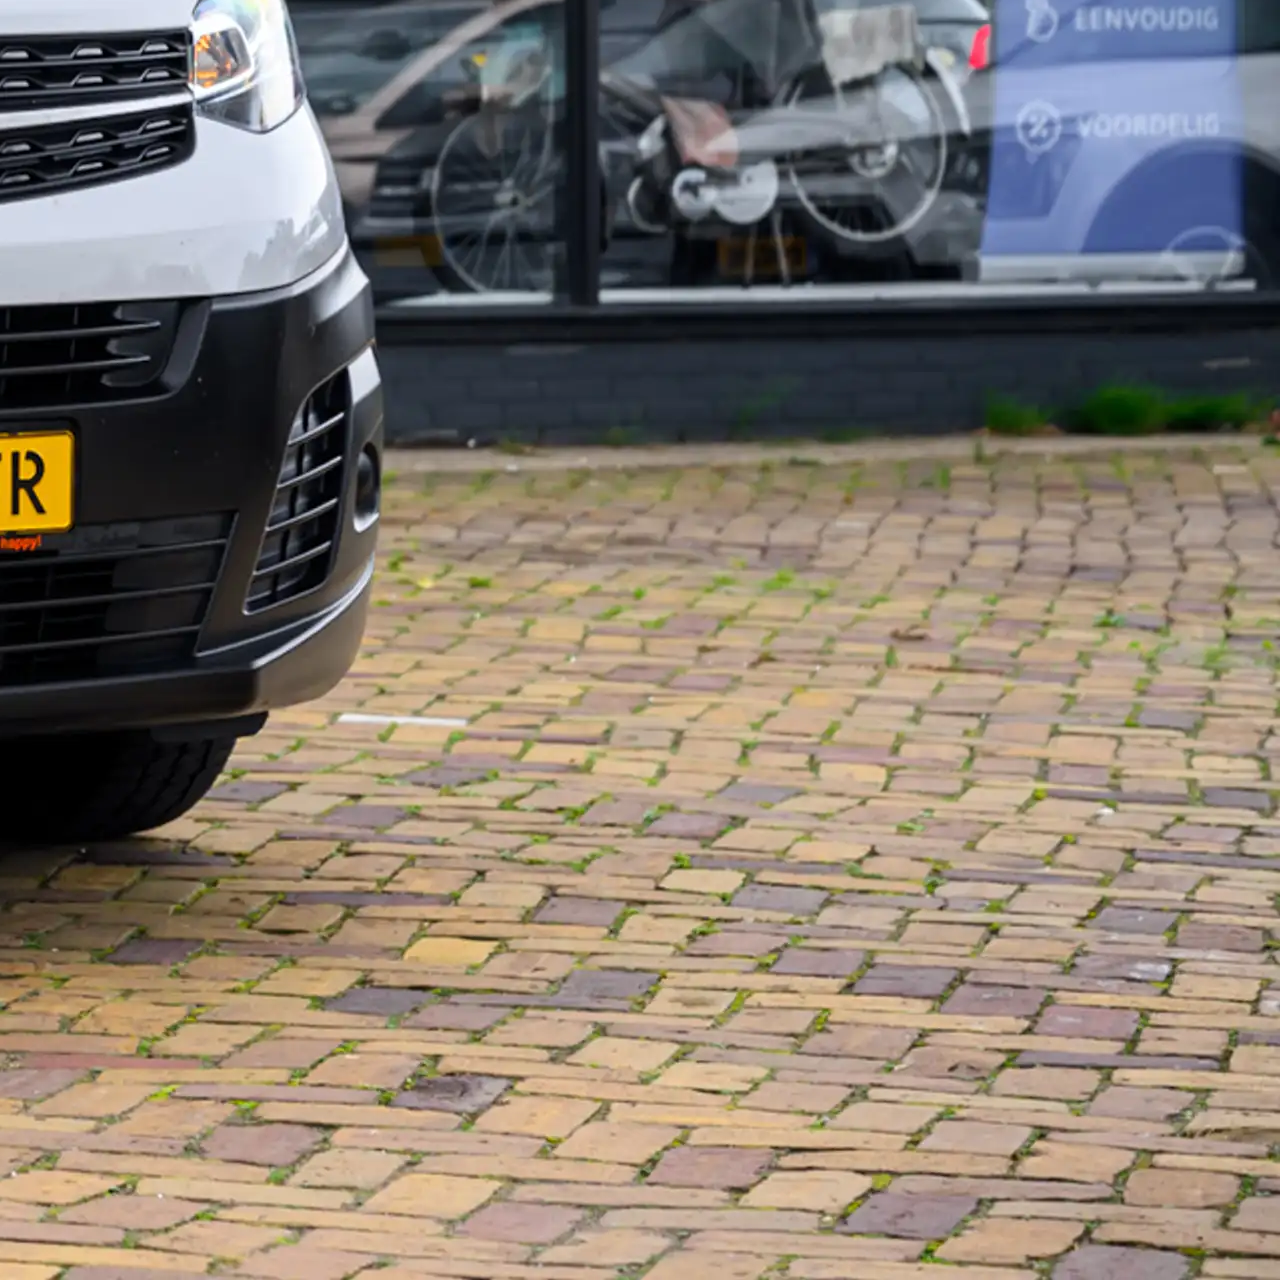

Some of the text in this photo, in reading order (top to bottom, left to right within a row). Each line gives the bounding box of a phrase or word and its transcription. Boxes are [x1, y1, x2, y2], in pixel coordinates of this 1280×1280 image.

[1074, 5, 1220, 32] EENVOUDIG
[1076, 111, 1221, 138] VOORDELIG
[0, 534, 43, 553] happy!
